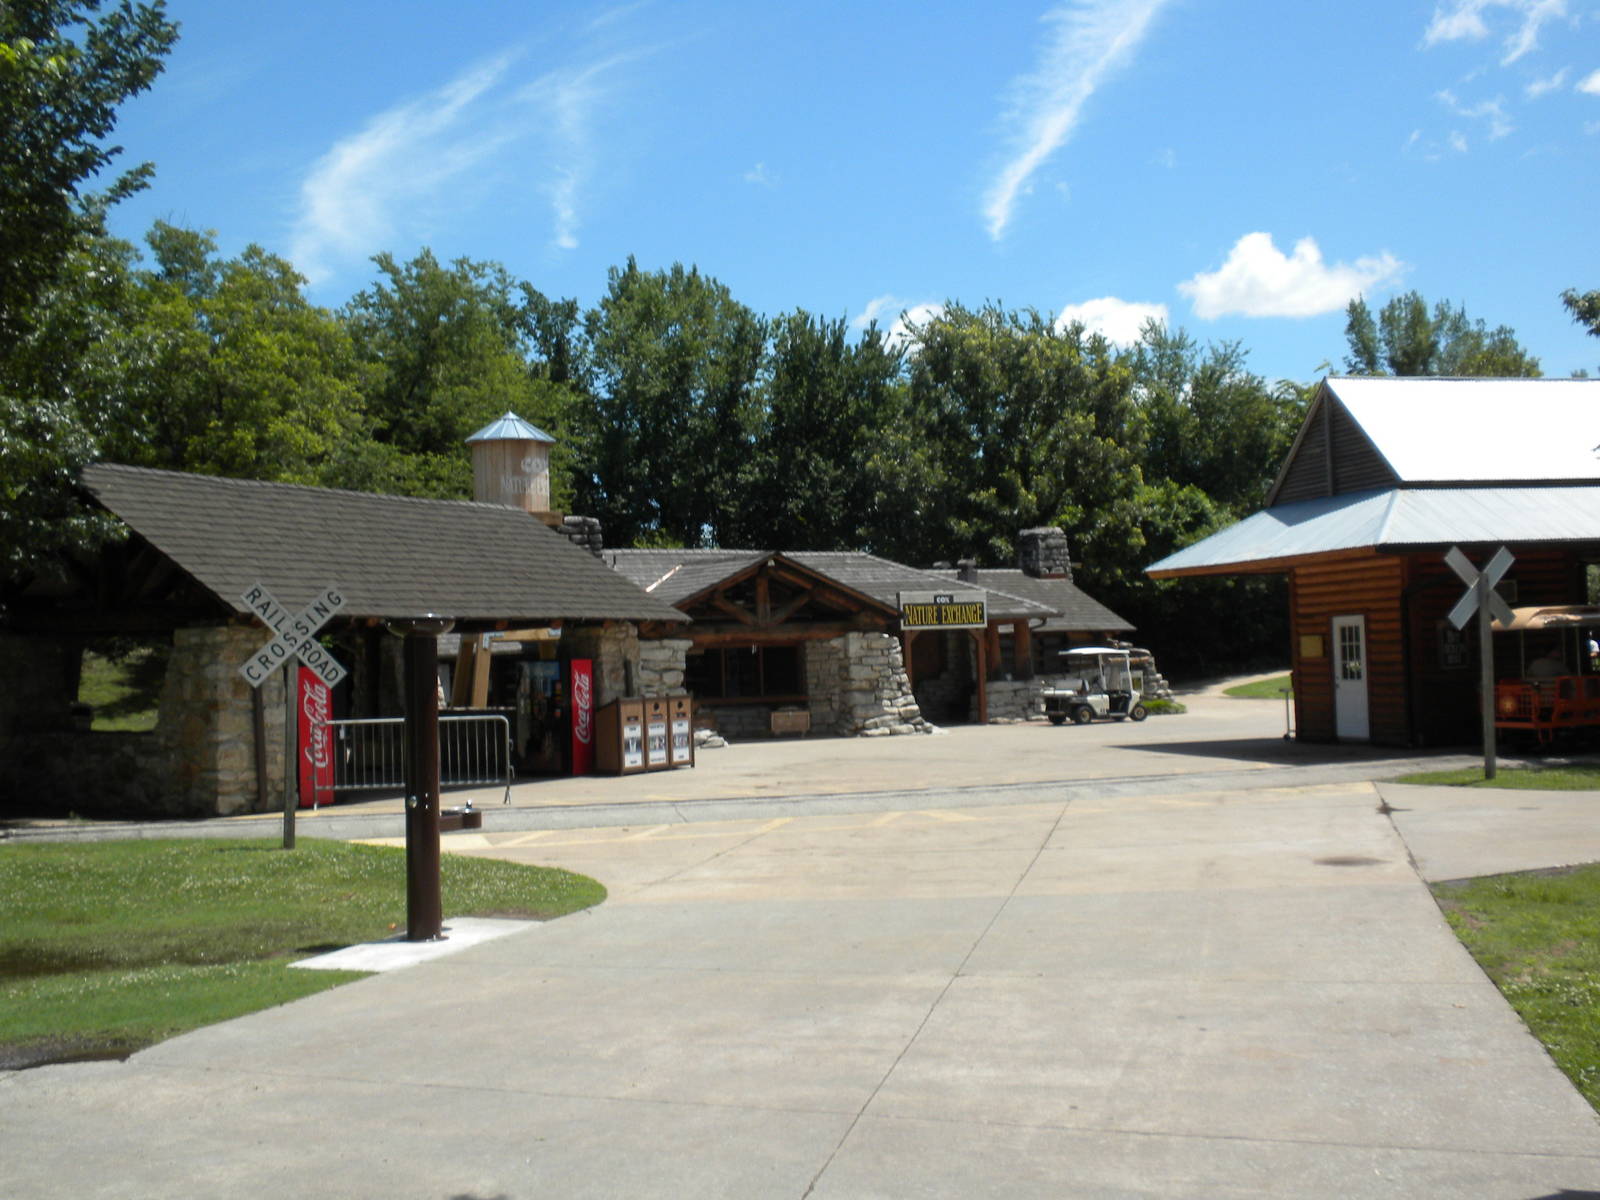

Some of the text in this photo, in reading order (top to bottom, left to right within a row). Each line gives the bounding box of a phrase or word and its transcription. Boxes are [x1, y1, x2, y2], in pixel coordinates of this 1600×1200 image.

[936, 596, 950, 604] COX
[905, 603, 983, 625] NATURE EXCHANGE
[246, 591, 342, 681] CROSSING
